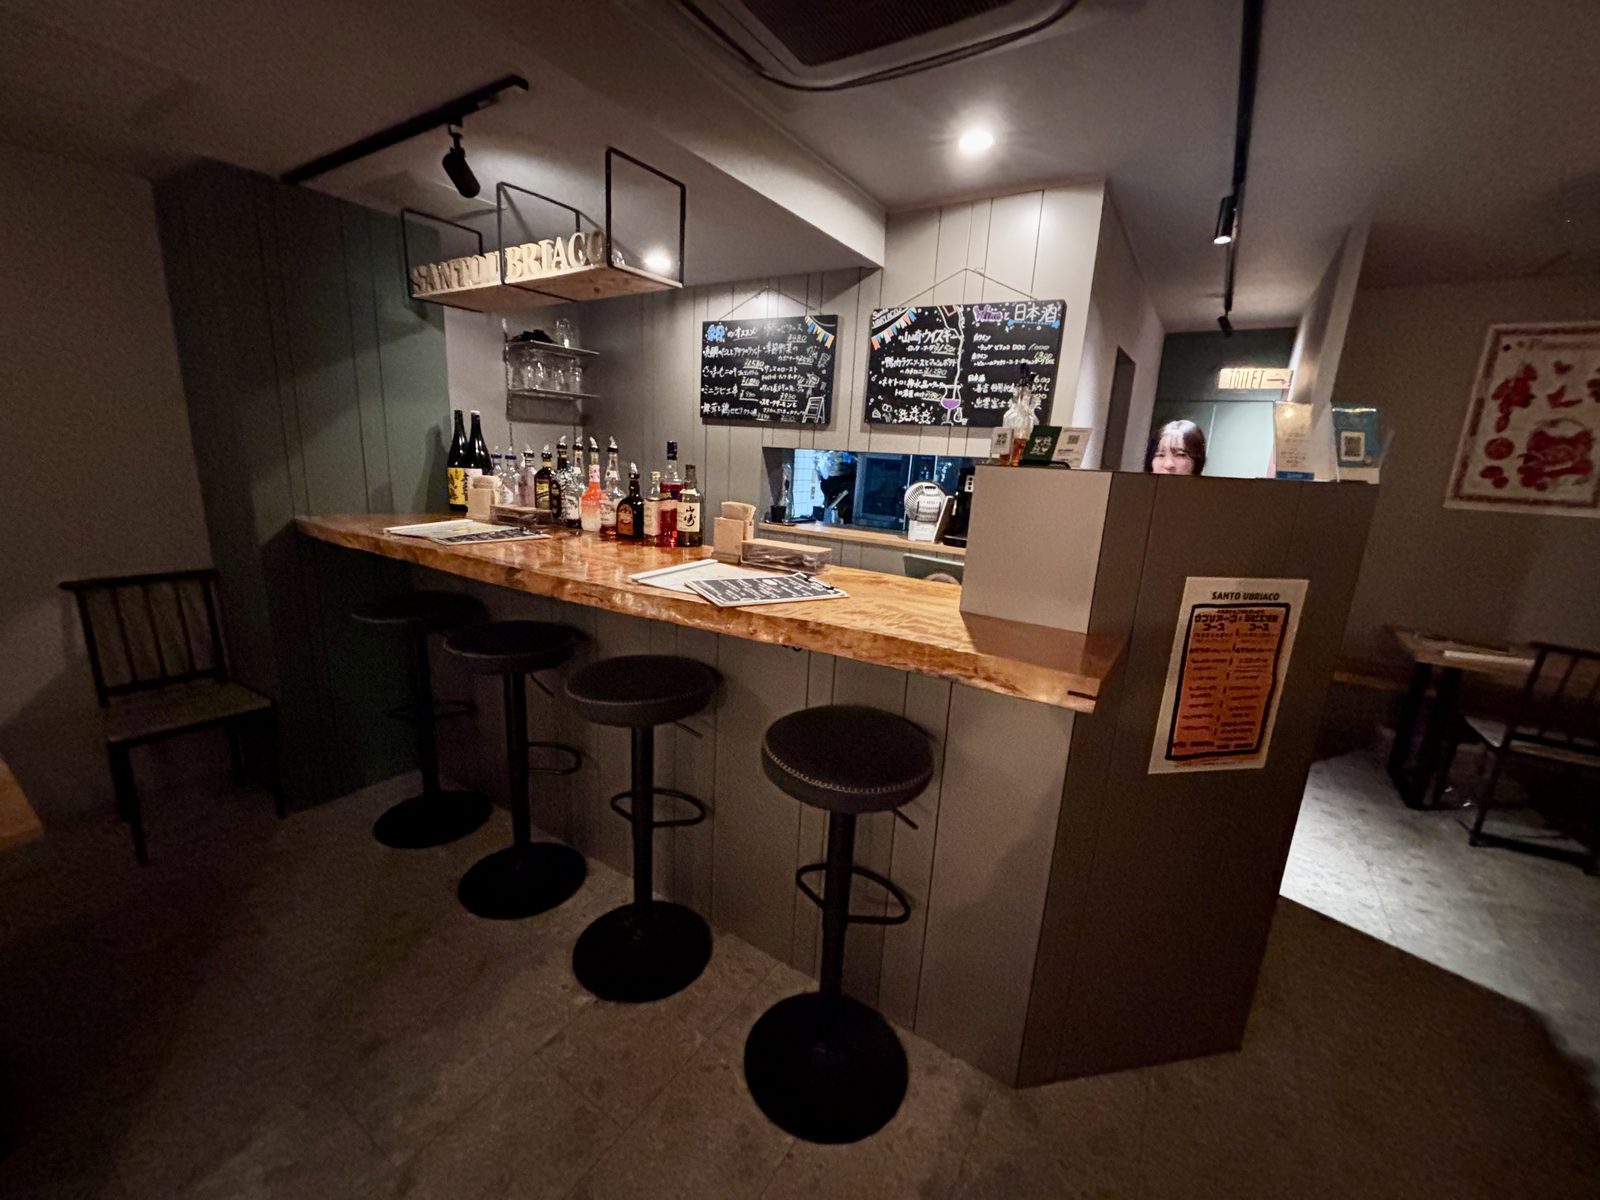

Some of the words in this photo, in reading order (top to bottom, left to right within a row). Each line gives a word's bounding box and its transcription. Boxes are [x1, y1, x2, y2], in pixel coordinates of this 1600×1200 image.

[1014, 303, 1057, 322] 日本酒
[1229, 370, 1265, 389] TOILET
[1211, 592, 1241, 600] SANTO
[1243, 592, 1280, 601] UBRIACO
